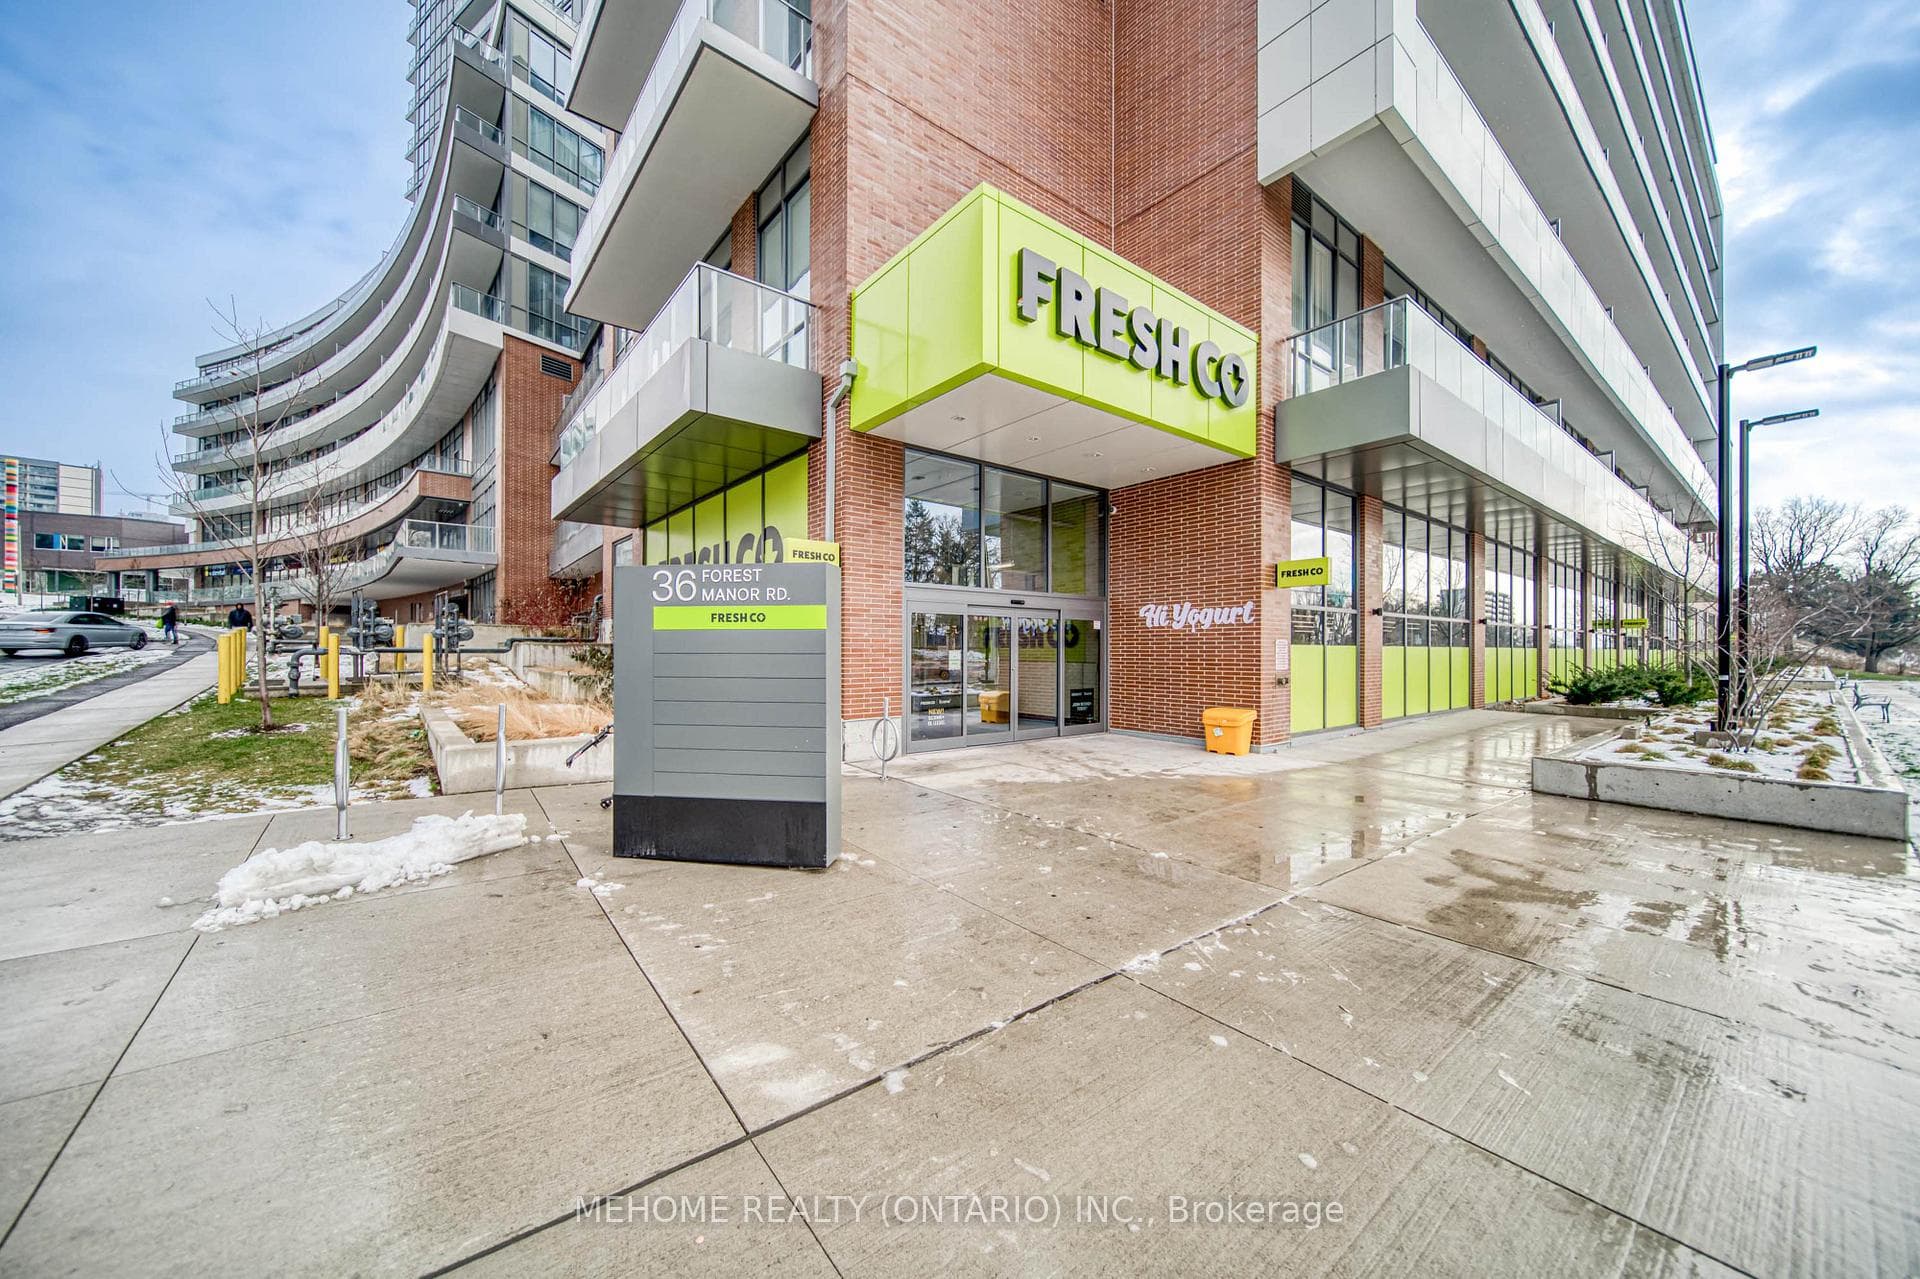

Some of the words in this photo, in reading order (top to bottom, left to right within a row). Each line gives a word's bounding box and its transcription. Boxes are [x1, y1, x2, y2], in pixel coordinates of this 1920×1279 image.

[652, 569, 697, 601] 36
[702, 569, 762, 582] FOREST
[702, 587, 760, 601] MANOR
[766, 587, 791, 601] RD.
[1139, 604, 1170, 628] Hi
[1171, 601, 1255, 634] Yogurt
